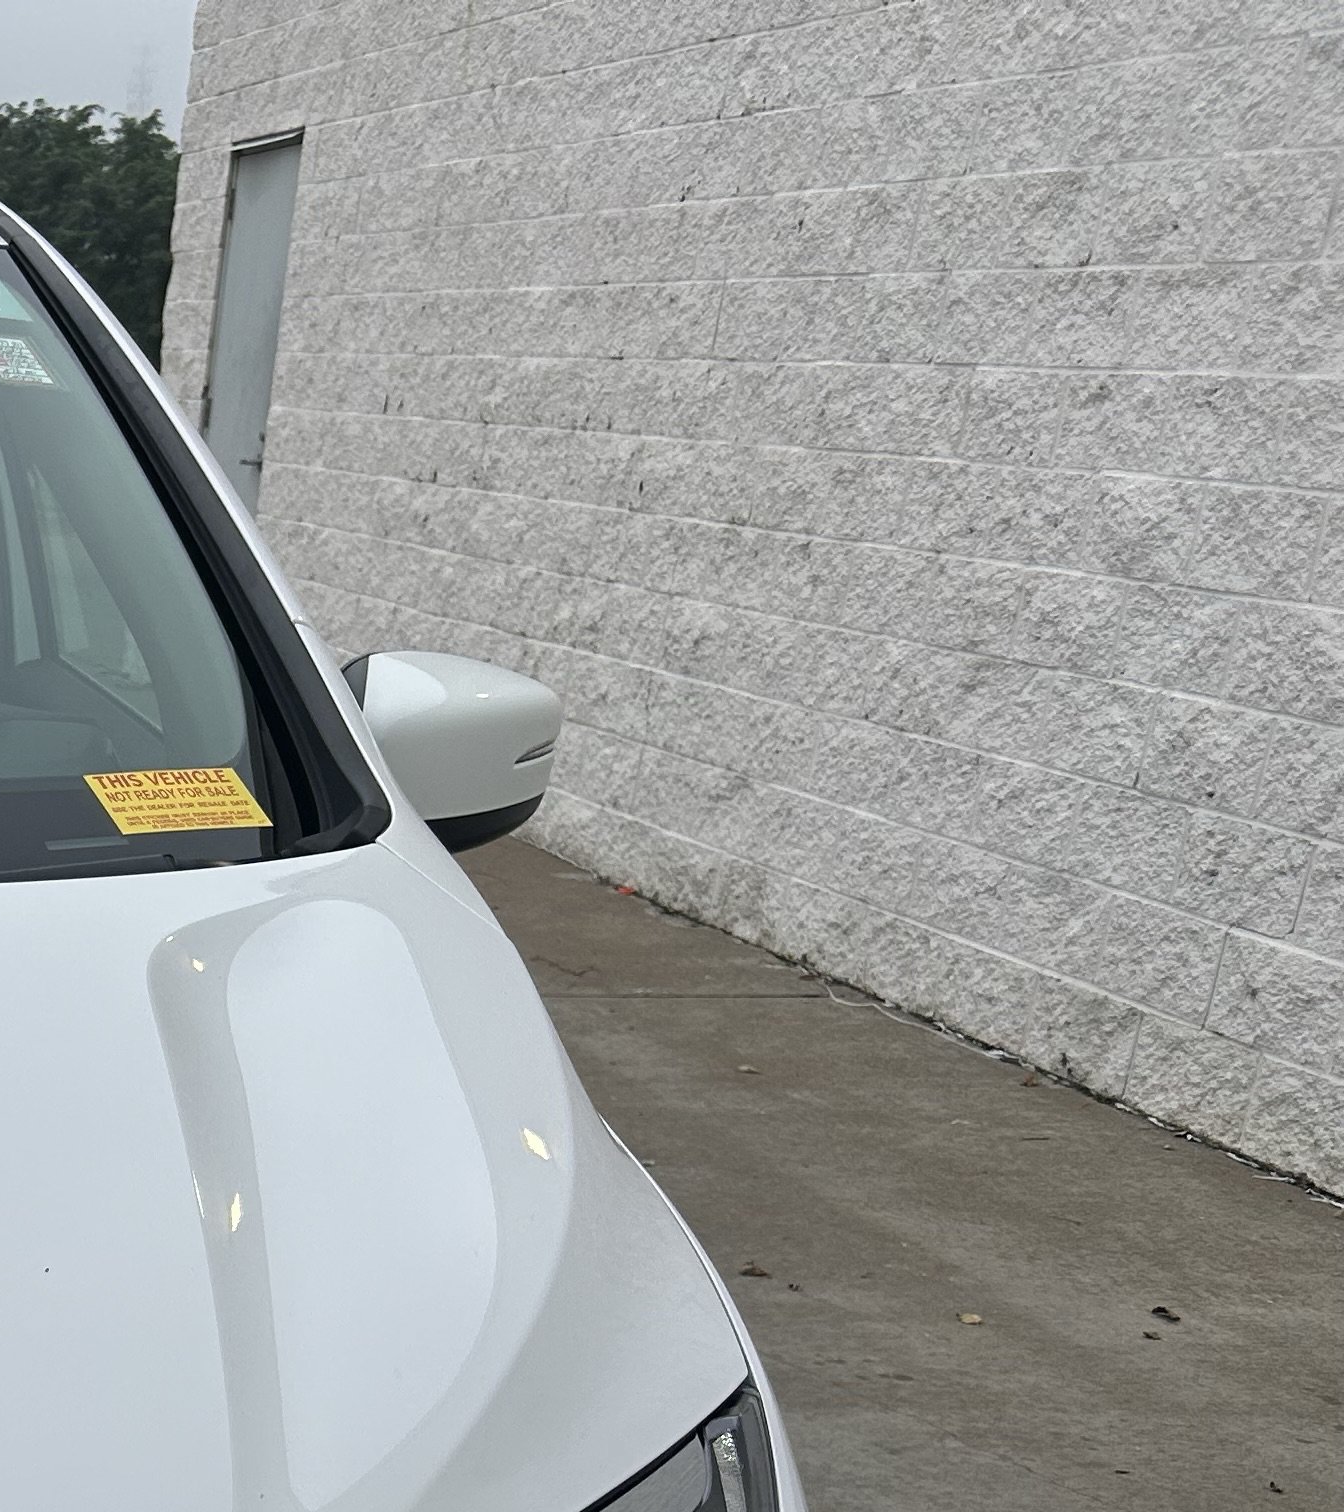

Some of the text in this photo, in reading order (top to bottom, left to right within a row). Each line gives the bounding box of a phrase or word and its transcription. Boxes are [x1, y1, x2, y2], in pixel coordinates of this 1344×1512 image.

[92, 769, 232, 790] THIS VEHICLE
[104, 785, 240, 804] NOT READY FOR SALE
